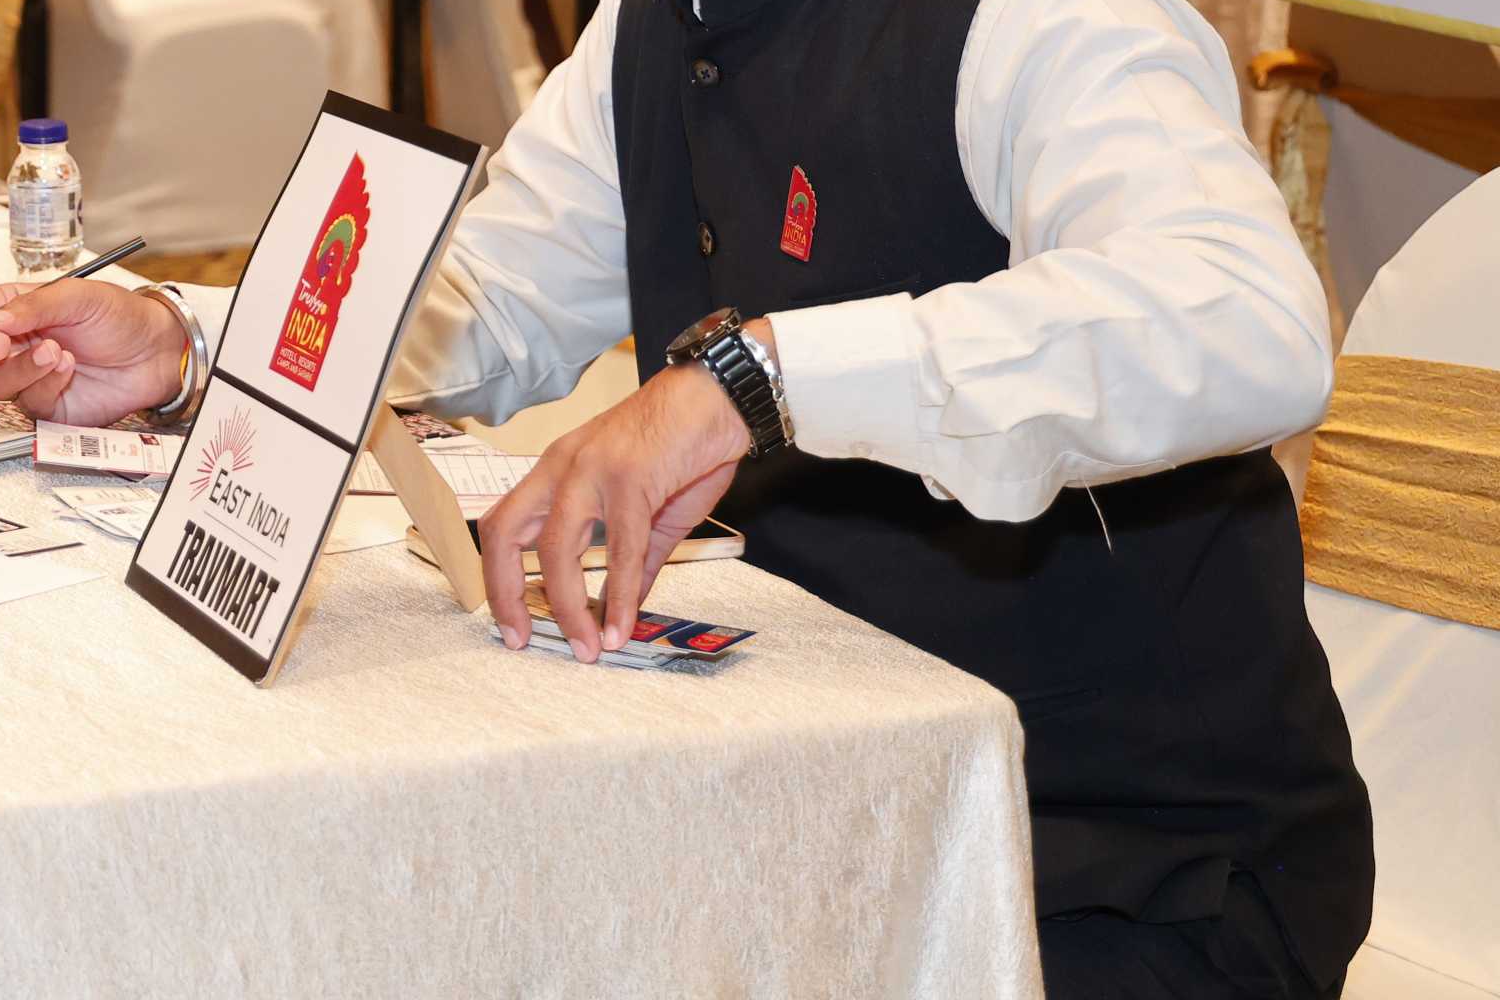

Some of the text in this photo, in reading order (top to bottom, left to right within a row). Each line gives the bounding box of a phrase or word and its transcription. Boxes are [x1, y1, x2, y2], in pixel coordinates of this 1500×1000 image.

[285, 307, 328, 355] INDIA
[209, 468, 291, 548] EAST INDIA
[166, 518, 281, 640] TRAVMART
